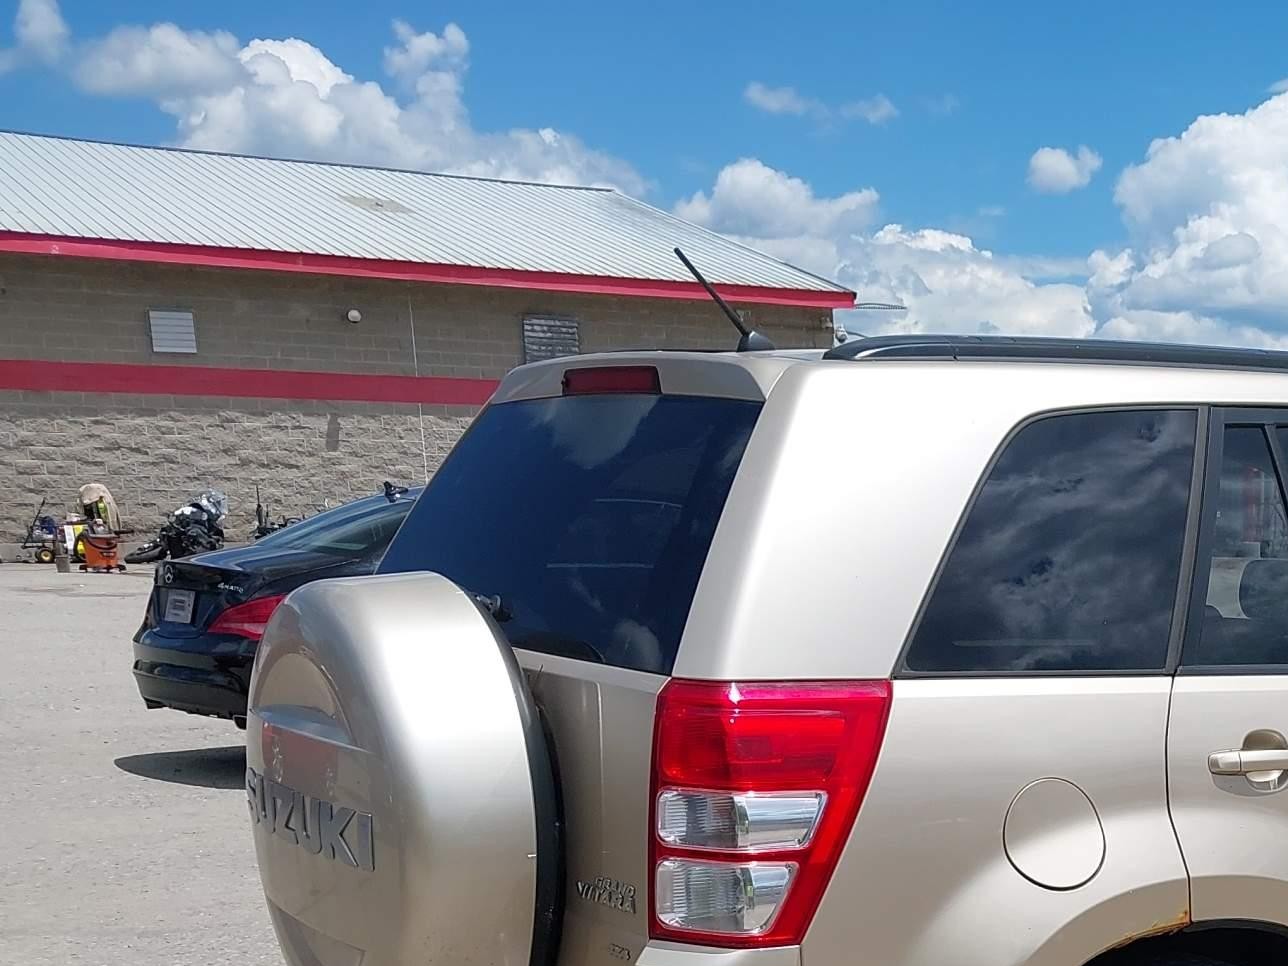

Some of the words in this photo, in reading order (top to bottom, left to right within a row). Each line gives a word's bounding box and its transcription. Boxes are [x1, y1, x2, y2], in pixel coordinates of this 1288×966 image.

[248, 767, 376, 872] SUZUKI
[576, 881, 637, 914] VITARA
[595, 876, 636, 898] GRAND
